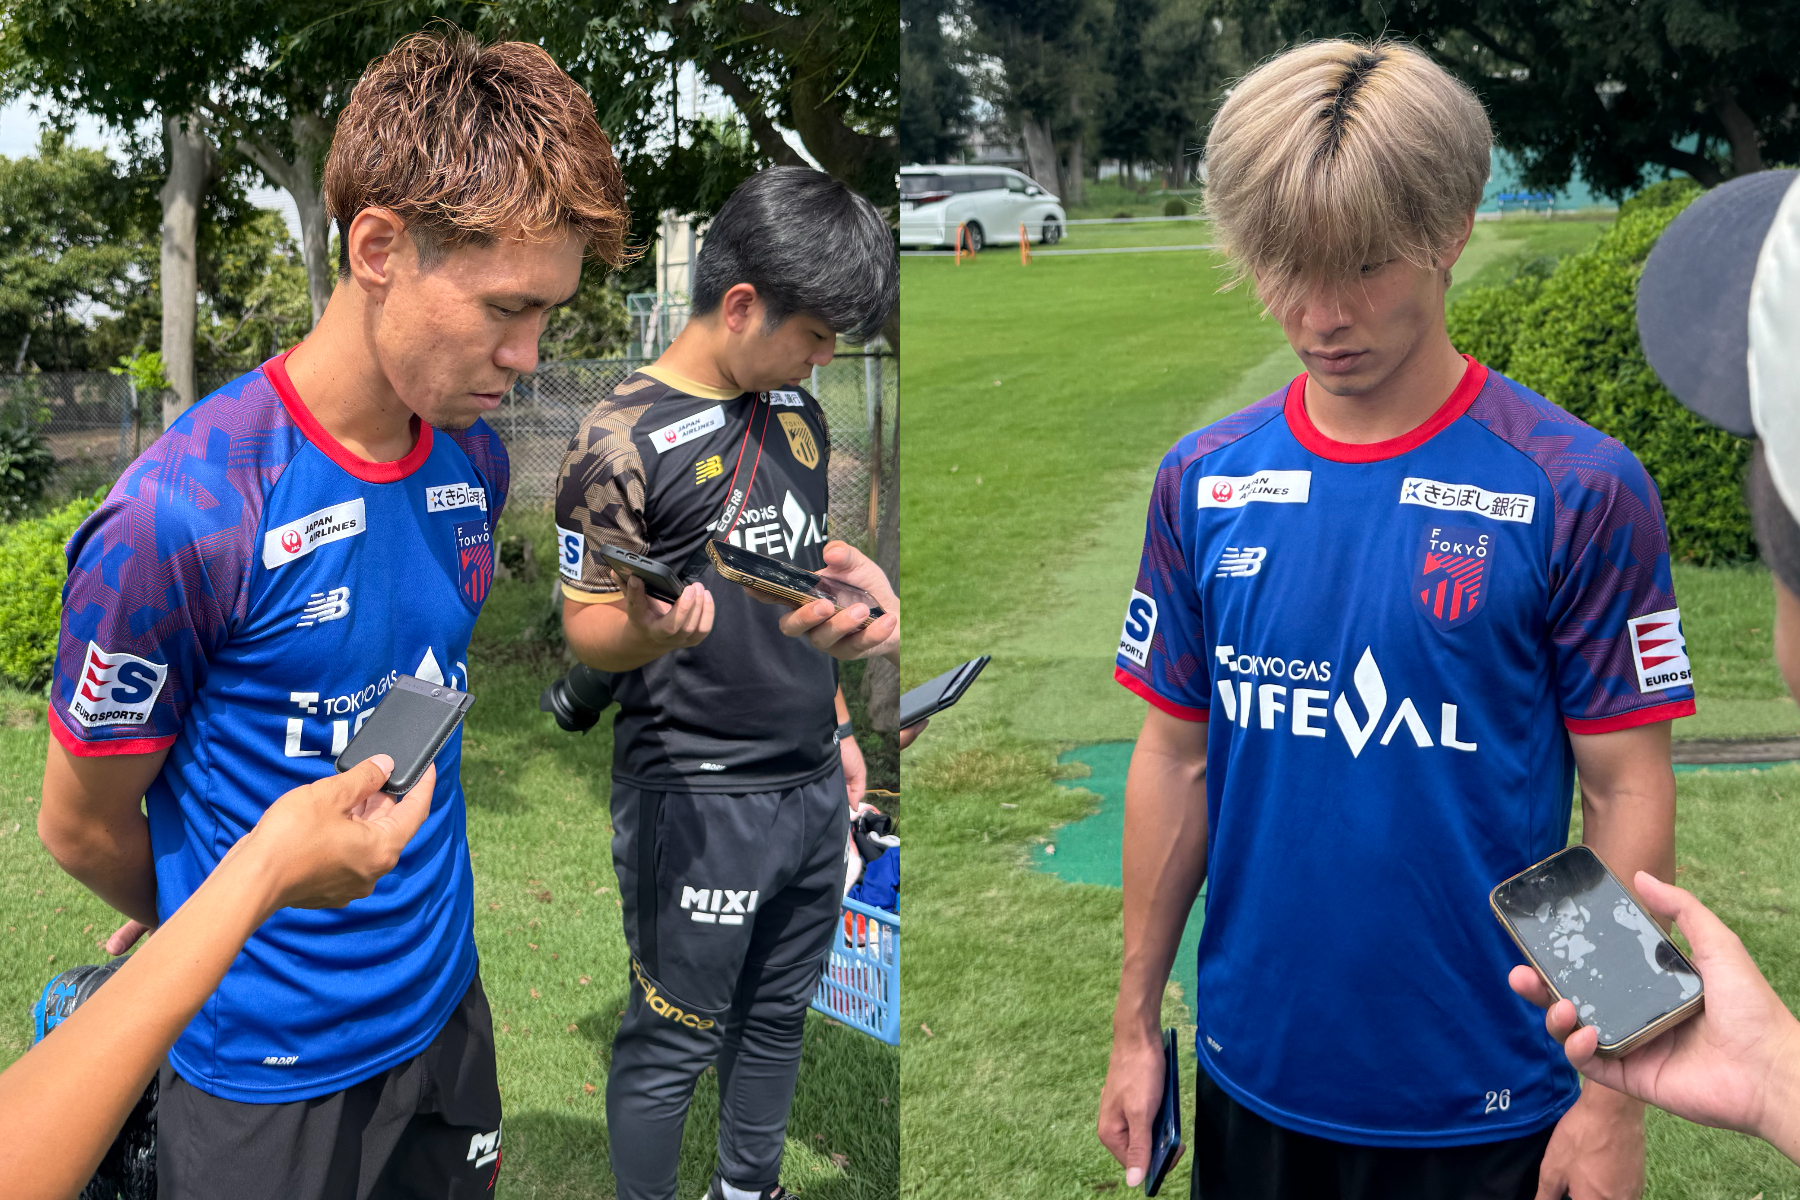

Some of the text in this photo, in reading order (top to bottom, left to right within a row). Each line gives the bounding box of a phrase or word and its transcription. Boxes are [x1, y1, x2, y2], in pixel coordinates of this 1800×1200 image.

[678, 419, 701, 432] JAPAN
[682, 420, 715, 437] AIRLINES
[716, 488, 743, 533] EOS R8
[1424, 484, 1529, 518] きらぼし銀行
[305, 515, 333, 535] JAPAN
[309, 519, 357, 544] AIRLINES
[457, 522, 489, 537] F C
[458, 532, 490, 547] TOKYO
[1431, 528, 1489, 545] F C
[1429, 539, 1487, 558] TOKYO
[1120, 641, 1144, 660] PORTS
[1288, 661, 1331, 682] GAS
[324, 670, 397, 715] TOKYO GAS
[680, 886, 759, 914] MIXI
[1485, 1088, 1510, 1114] 26
